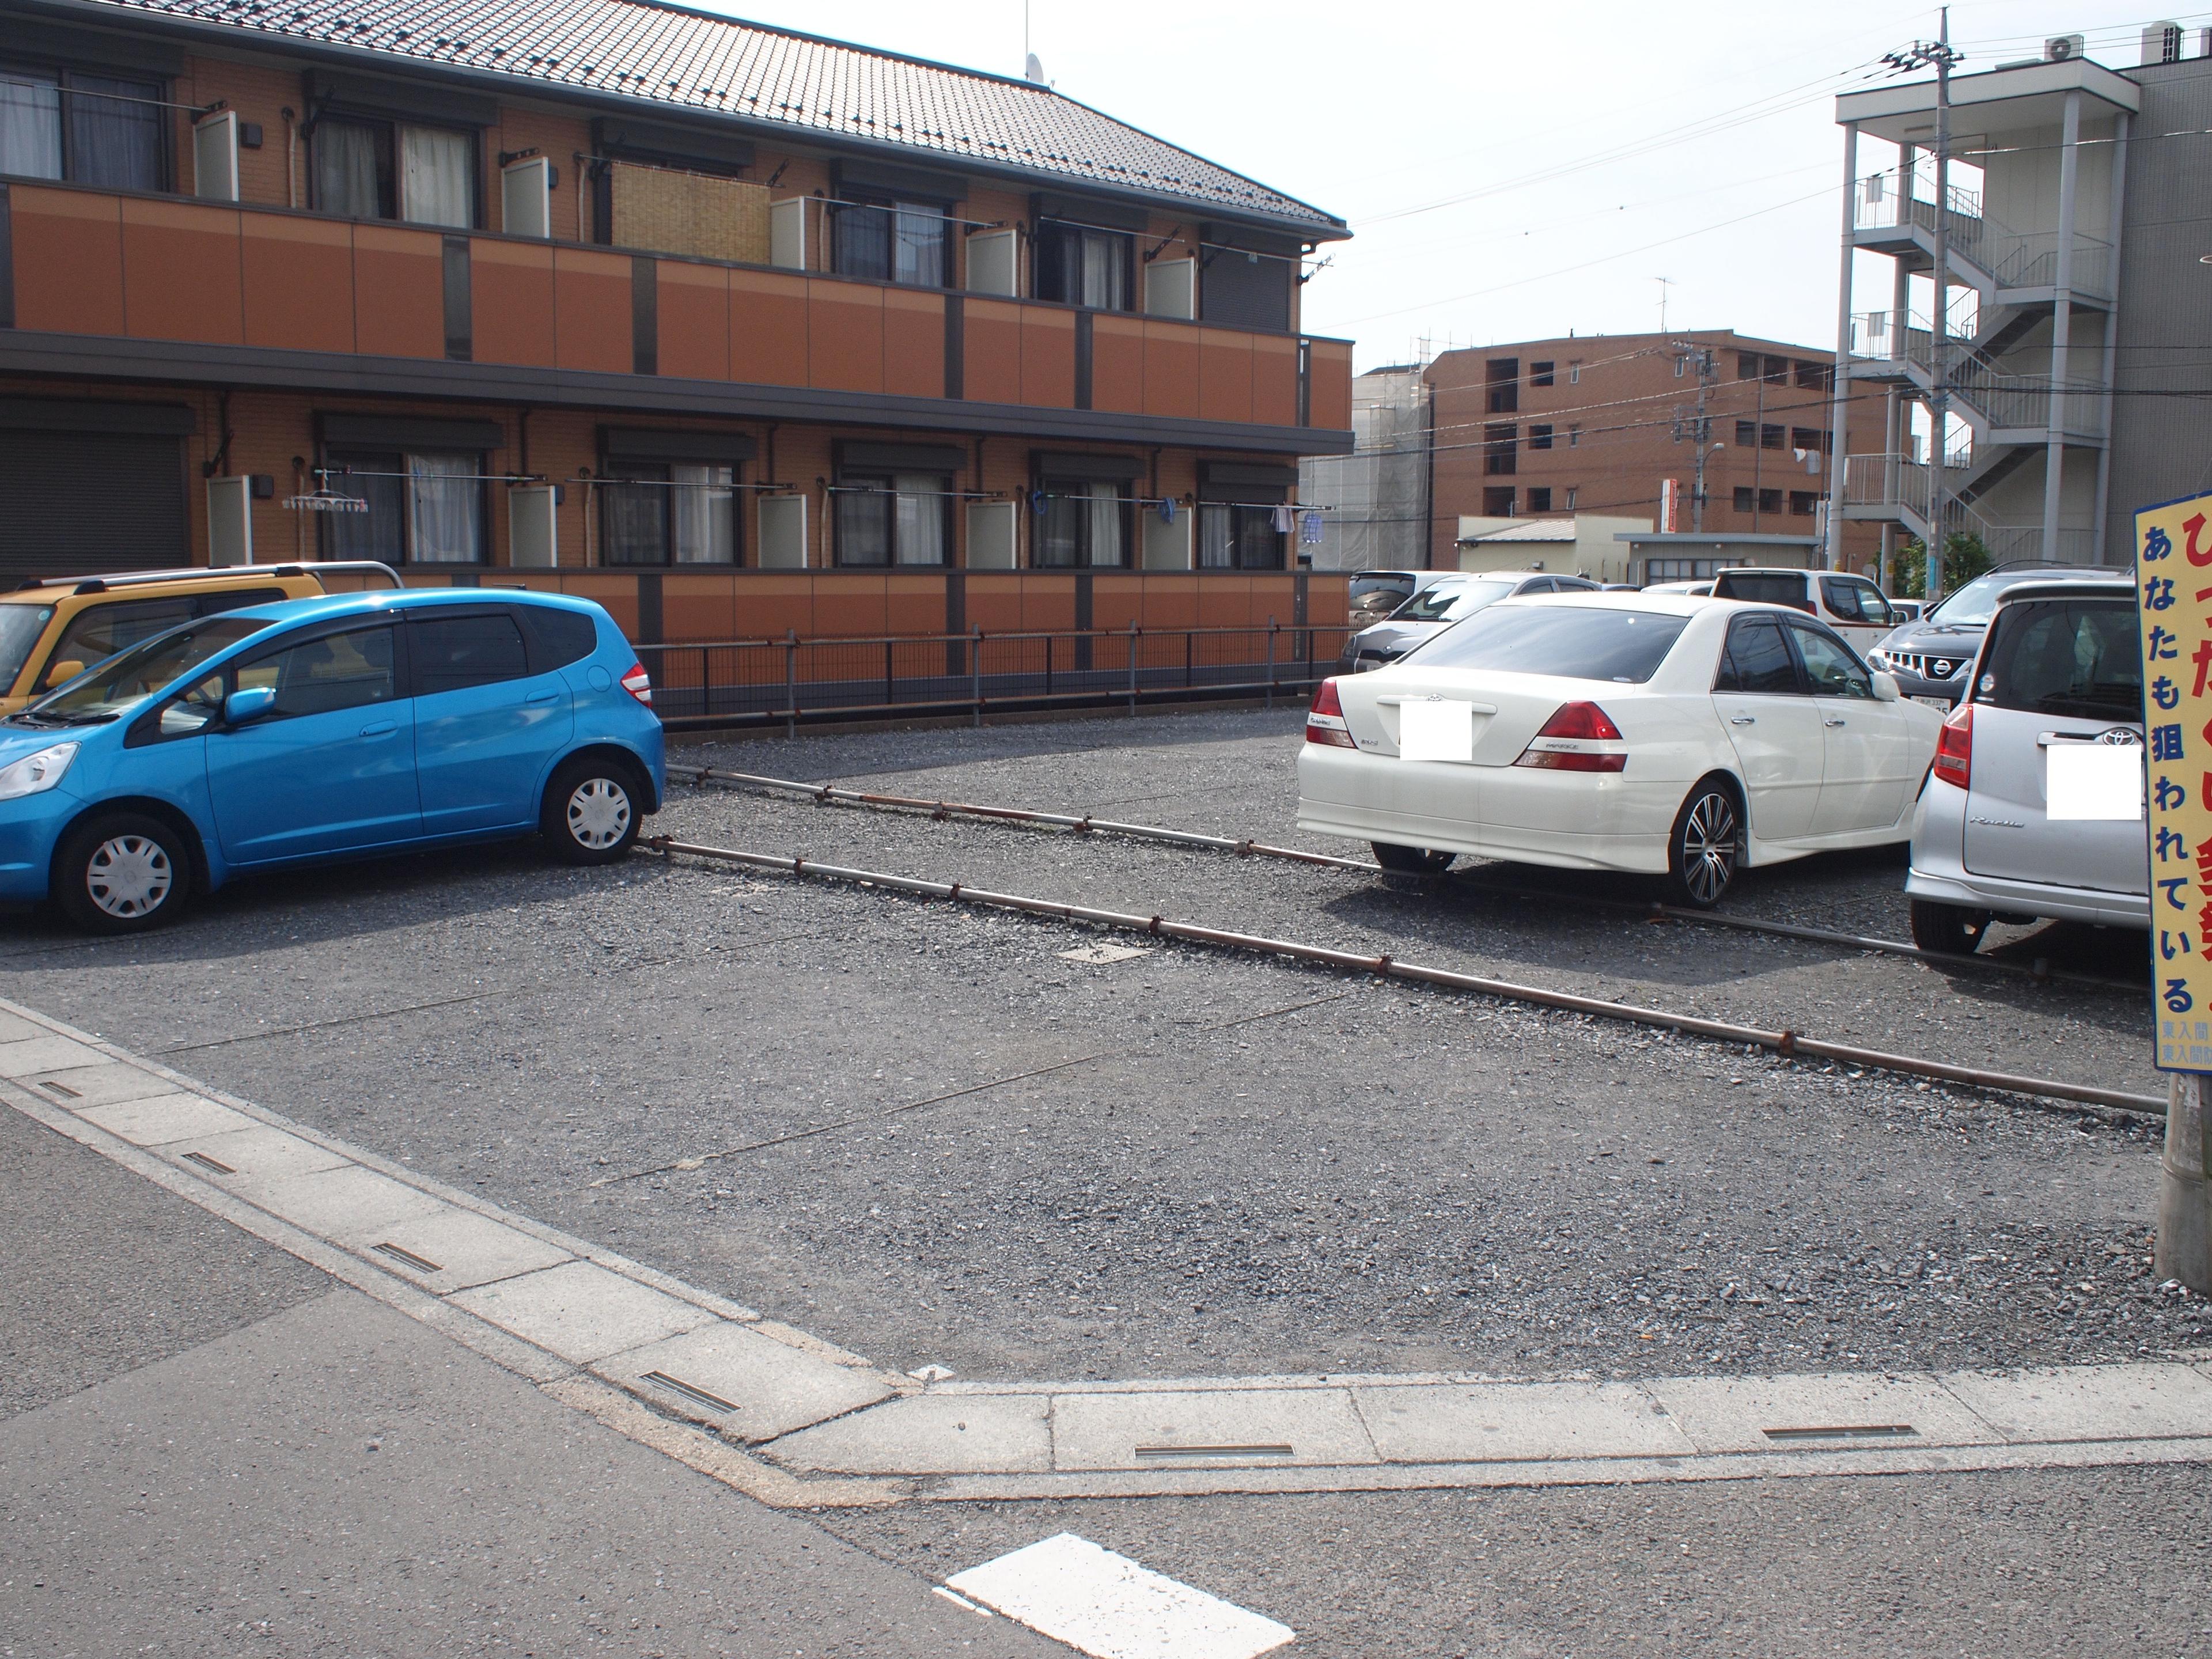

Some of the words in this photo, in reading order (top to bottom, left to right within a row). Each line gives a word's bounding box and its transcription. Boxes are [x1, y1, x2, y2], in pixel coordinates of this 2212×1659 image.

[2142, 526, 2192, 1013] あなたも狙われている
[2161, 1020, 2212, 1041] 東入間
